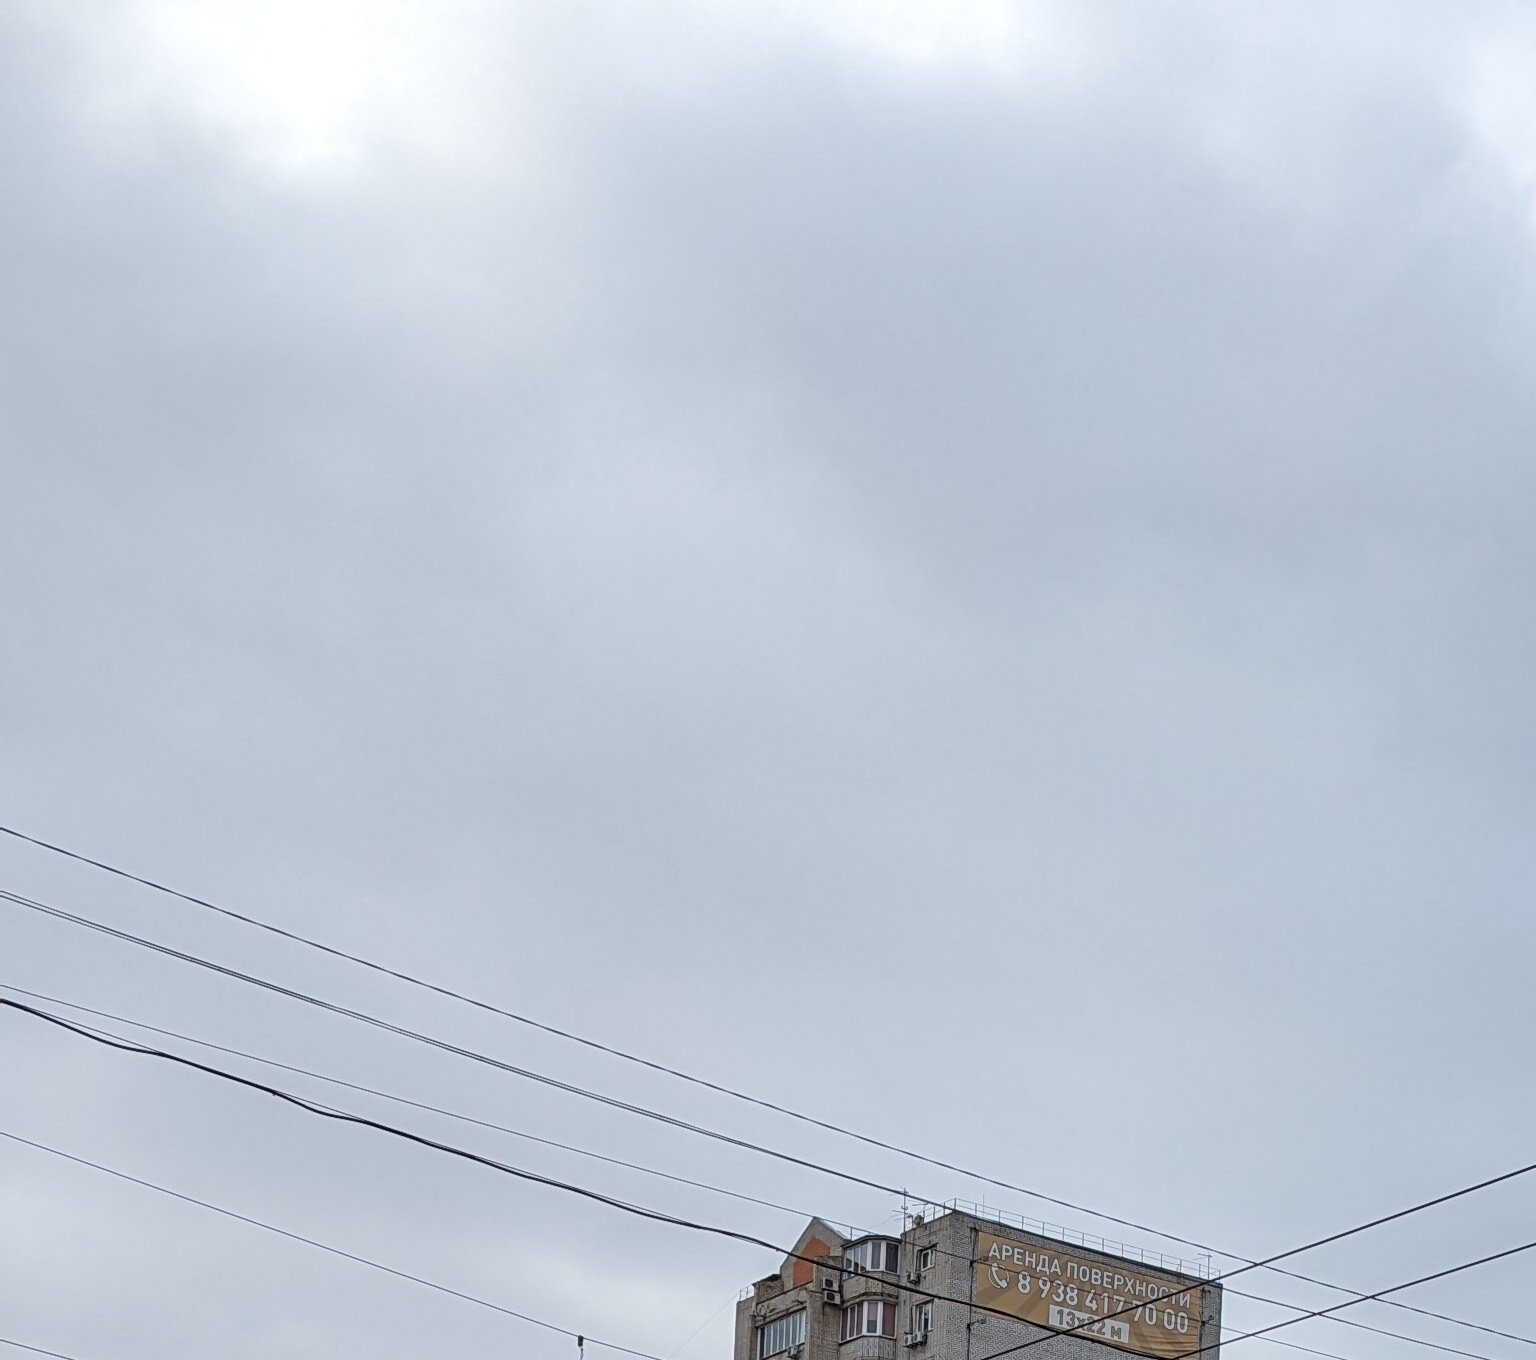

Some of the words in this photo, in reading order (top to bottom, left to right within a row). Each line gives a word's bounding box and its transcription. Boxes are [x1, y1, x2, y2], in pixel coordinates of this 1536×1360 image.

[988, 1241, 1062, 1276] АРЕНДА
[1066, 1262, 1191, 1309] ПОВЕРХНОСТИ
[1018, 1271, 1031, 1294] 8
[1038, 1276, 1079, 1306] 938
[1084, 1288, 1125, 1315] 417
[1131, 1301, 1157, 1326] 70
[1163, 1308, 1189, 1334] 00
